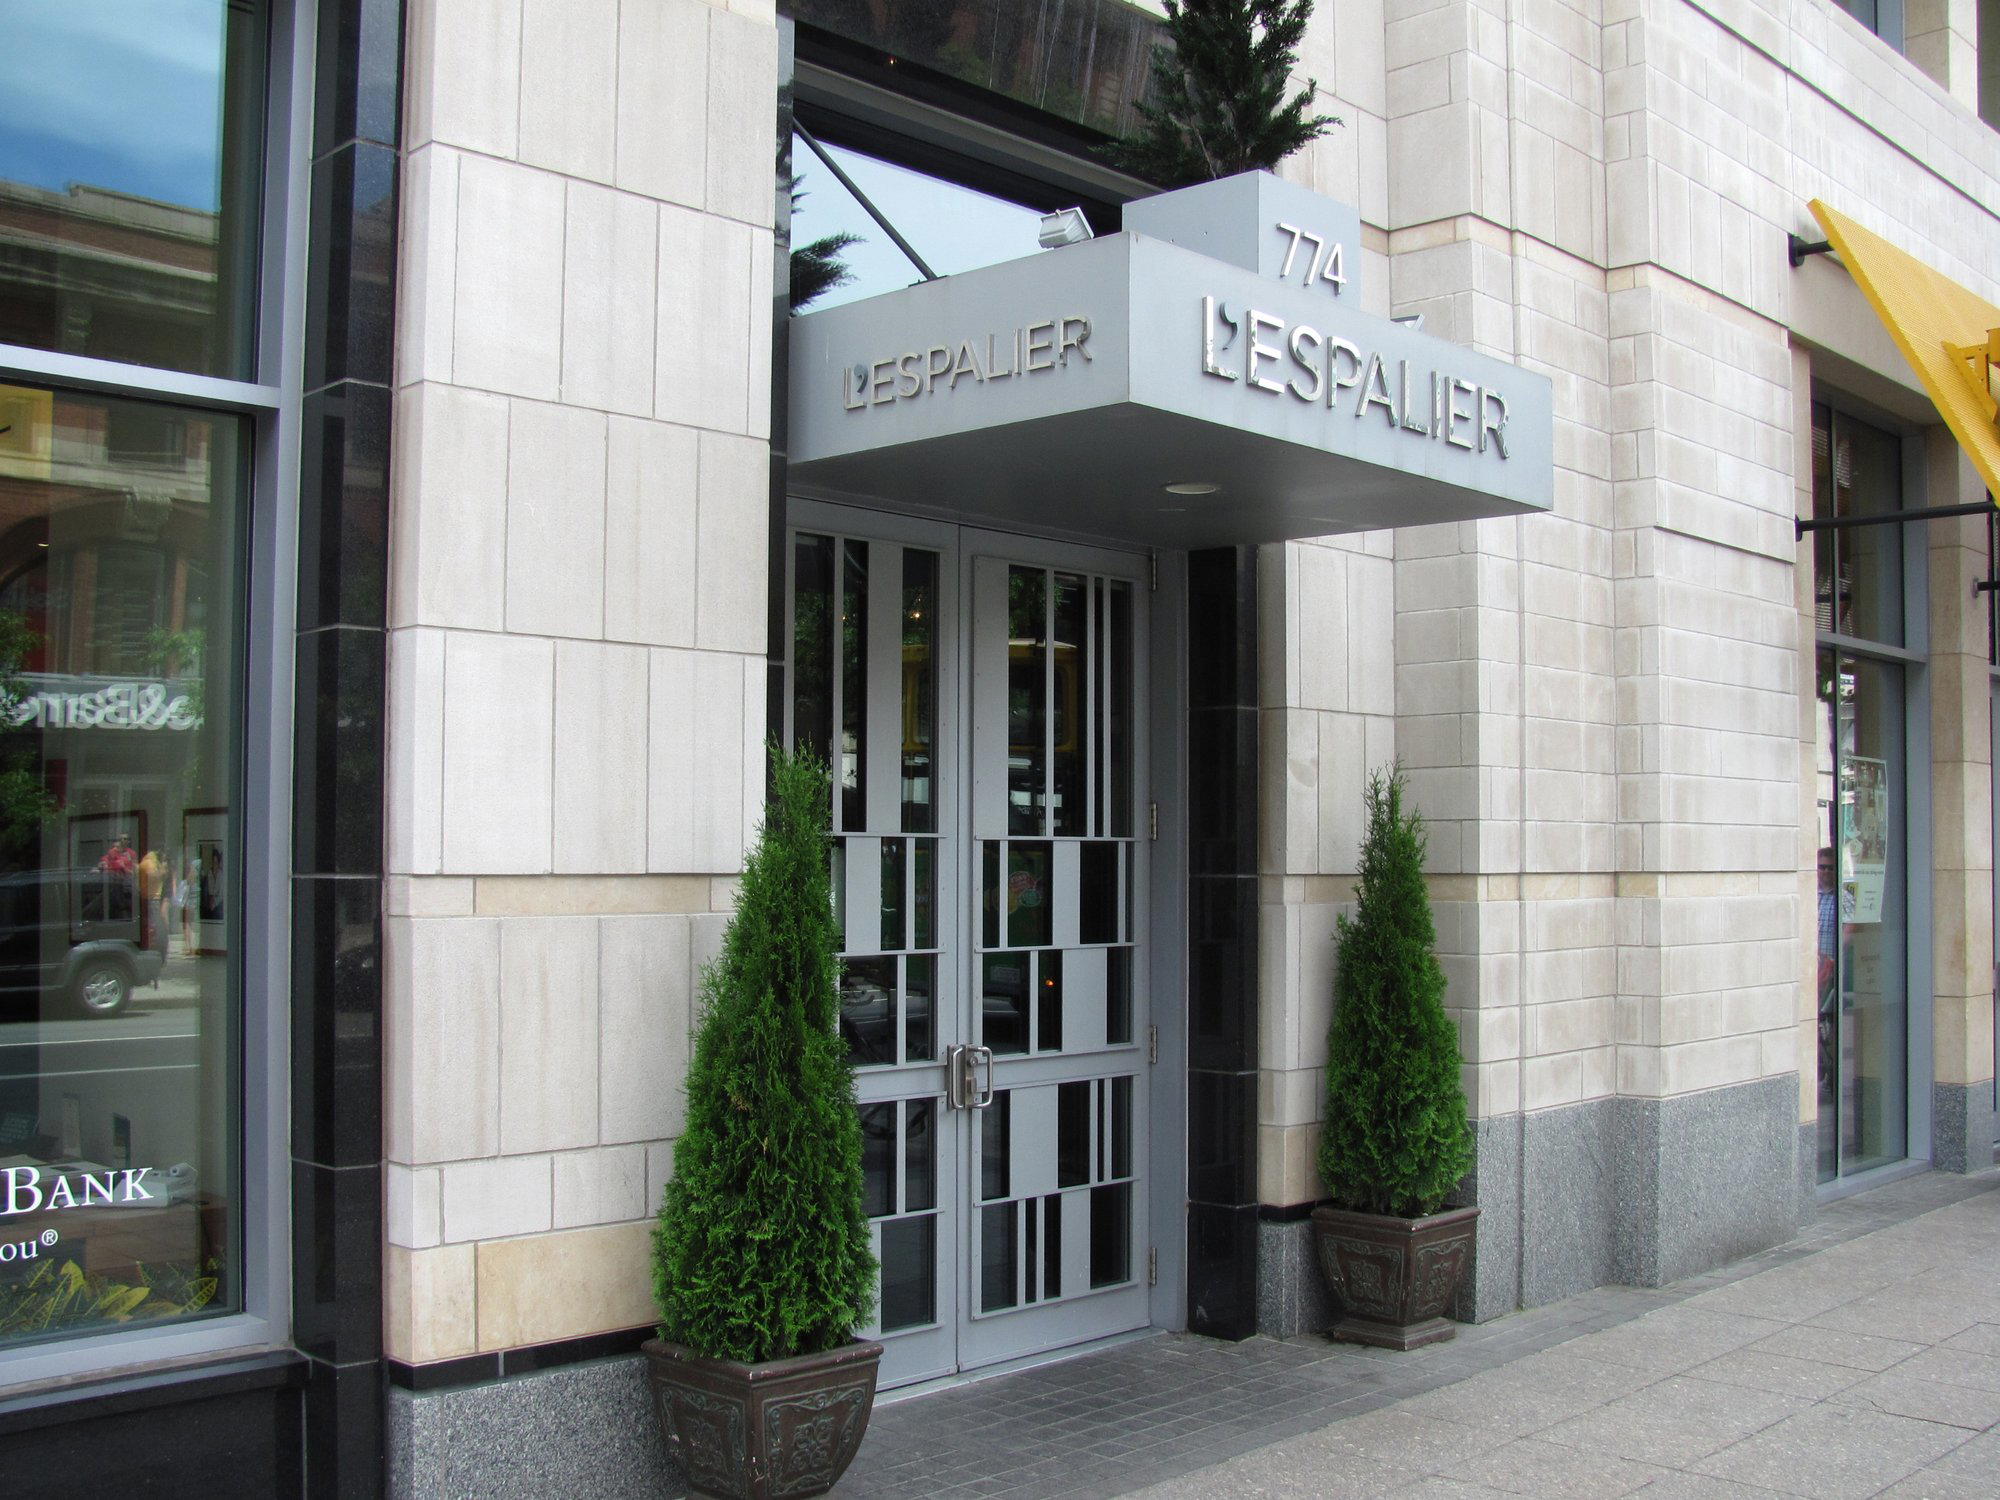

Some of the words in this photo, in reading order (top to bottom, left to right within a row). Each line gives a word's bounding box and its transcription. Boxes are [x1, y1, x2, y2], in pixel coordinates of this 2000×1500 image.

[1276, 222, 1347, 296] 774
[843, 314, 1093, 411] L'ESPALIER
[1202, 296, 1510, 460] L'ESPALIER
[0, 1166, 153, 1215] BANK
